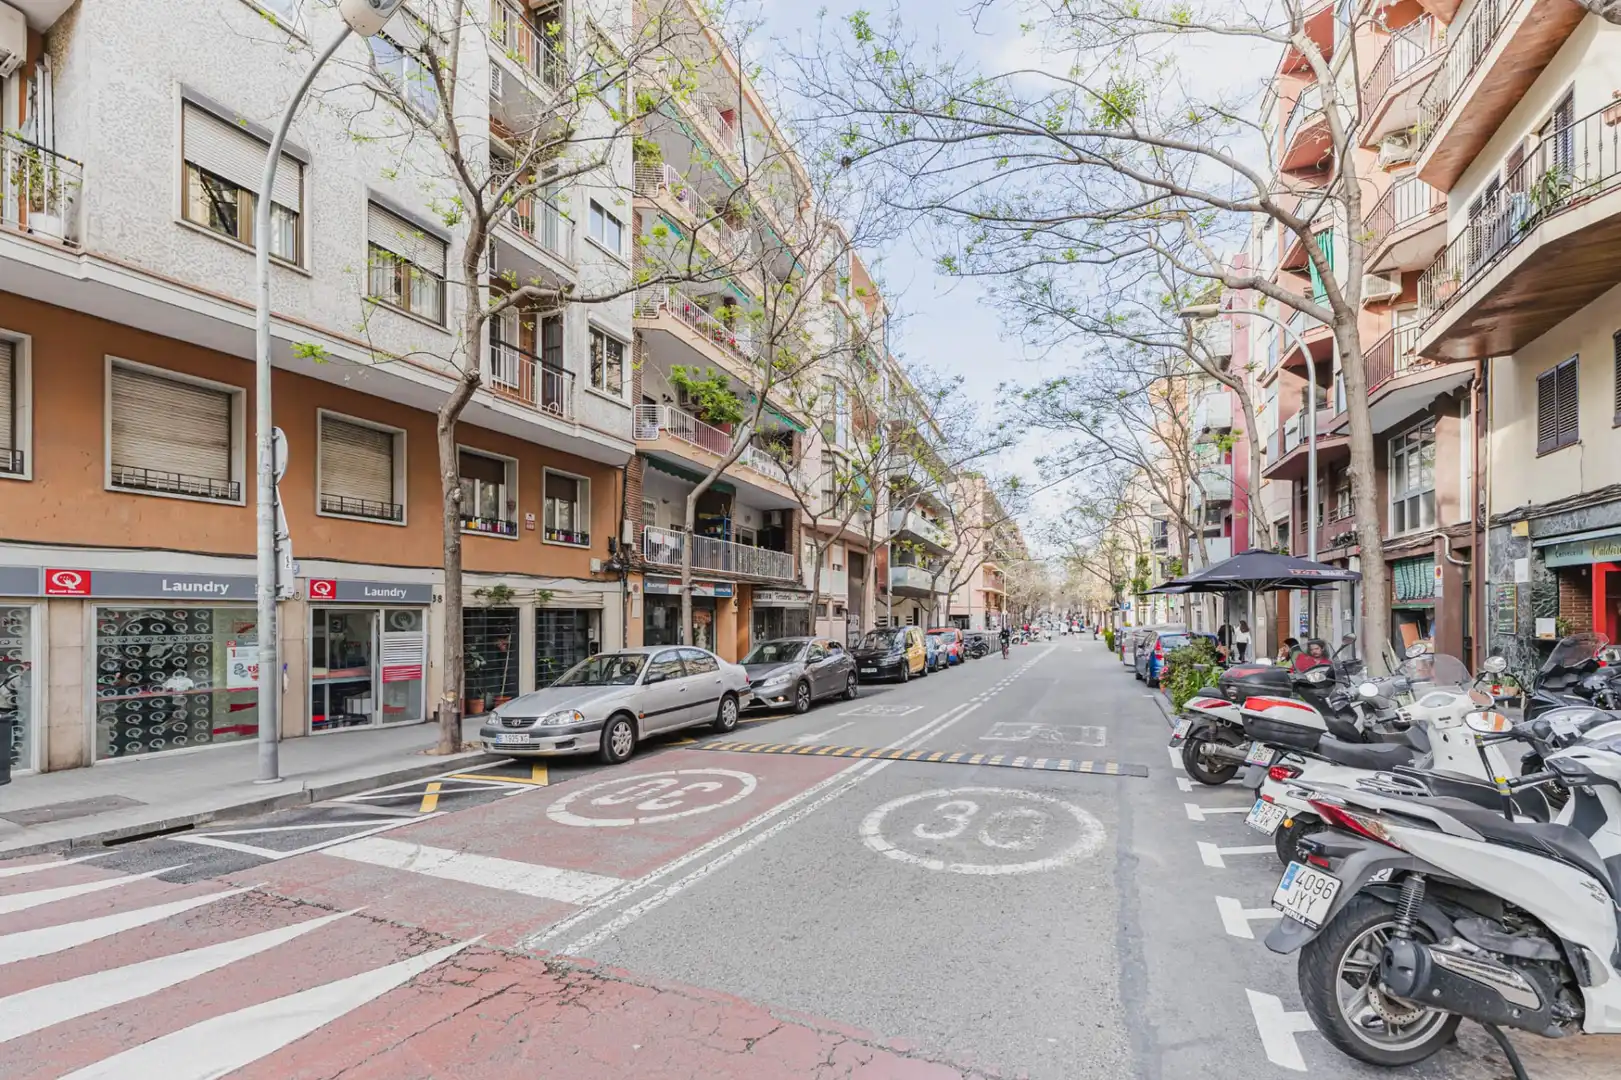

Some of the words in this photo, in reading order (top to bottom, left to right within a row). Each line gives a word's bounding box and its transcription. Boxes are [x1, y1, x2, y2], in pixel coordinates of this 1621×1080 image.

[162, 579, 230, 595] Laundry
[364, 586, 407, 599] Laundry
[912, 800, 1048, 850] 30
[1295, 870, 1335, 900] 4096
[1286, 889, 1317, 914] JYY
